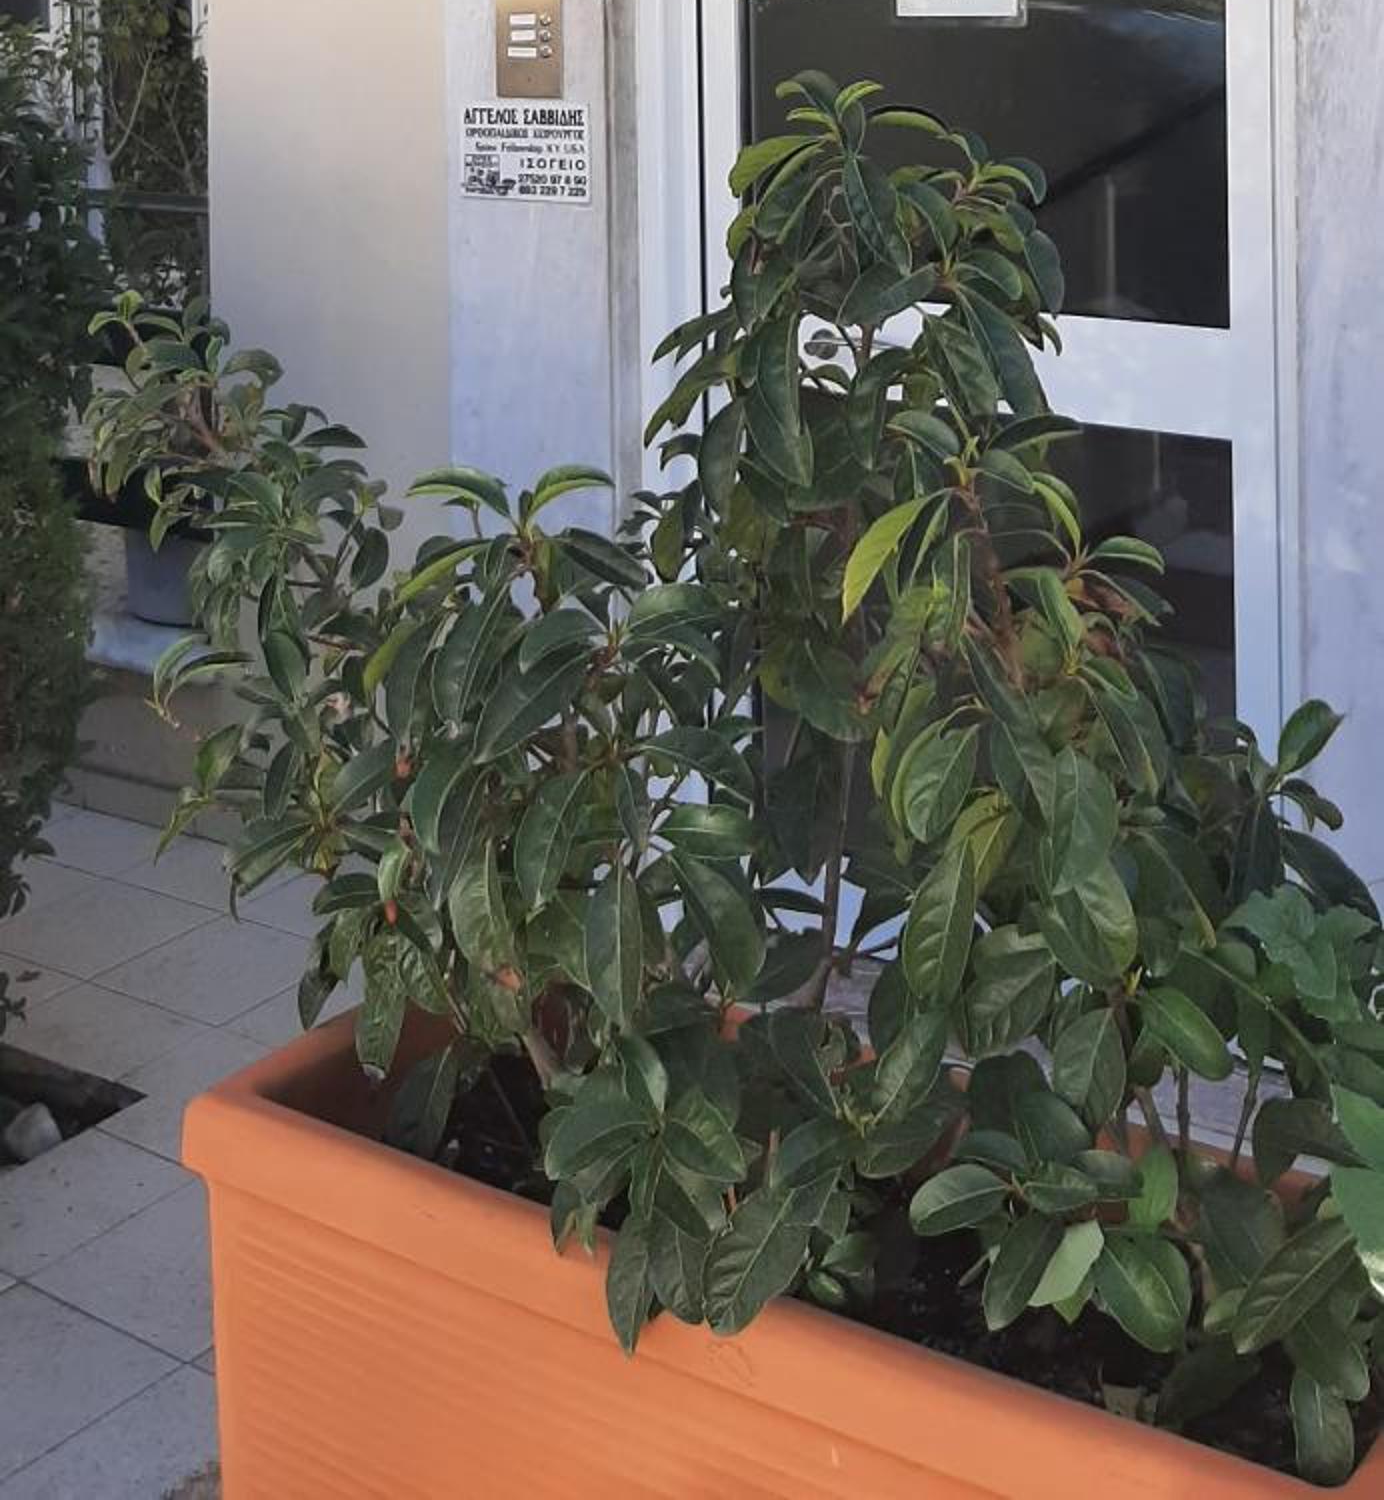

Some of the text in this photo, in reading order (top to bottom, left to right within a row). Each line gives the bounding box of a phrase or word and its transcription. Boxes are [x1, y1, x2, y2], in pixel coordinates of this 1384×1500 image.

[464, 108, 585, 127] ΑΓΓΕΛΟΣ ΣΑΒΒΙΔΗΣ
[520, 158, 585, 170] ΙΣΟΓΕΙΟ
